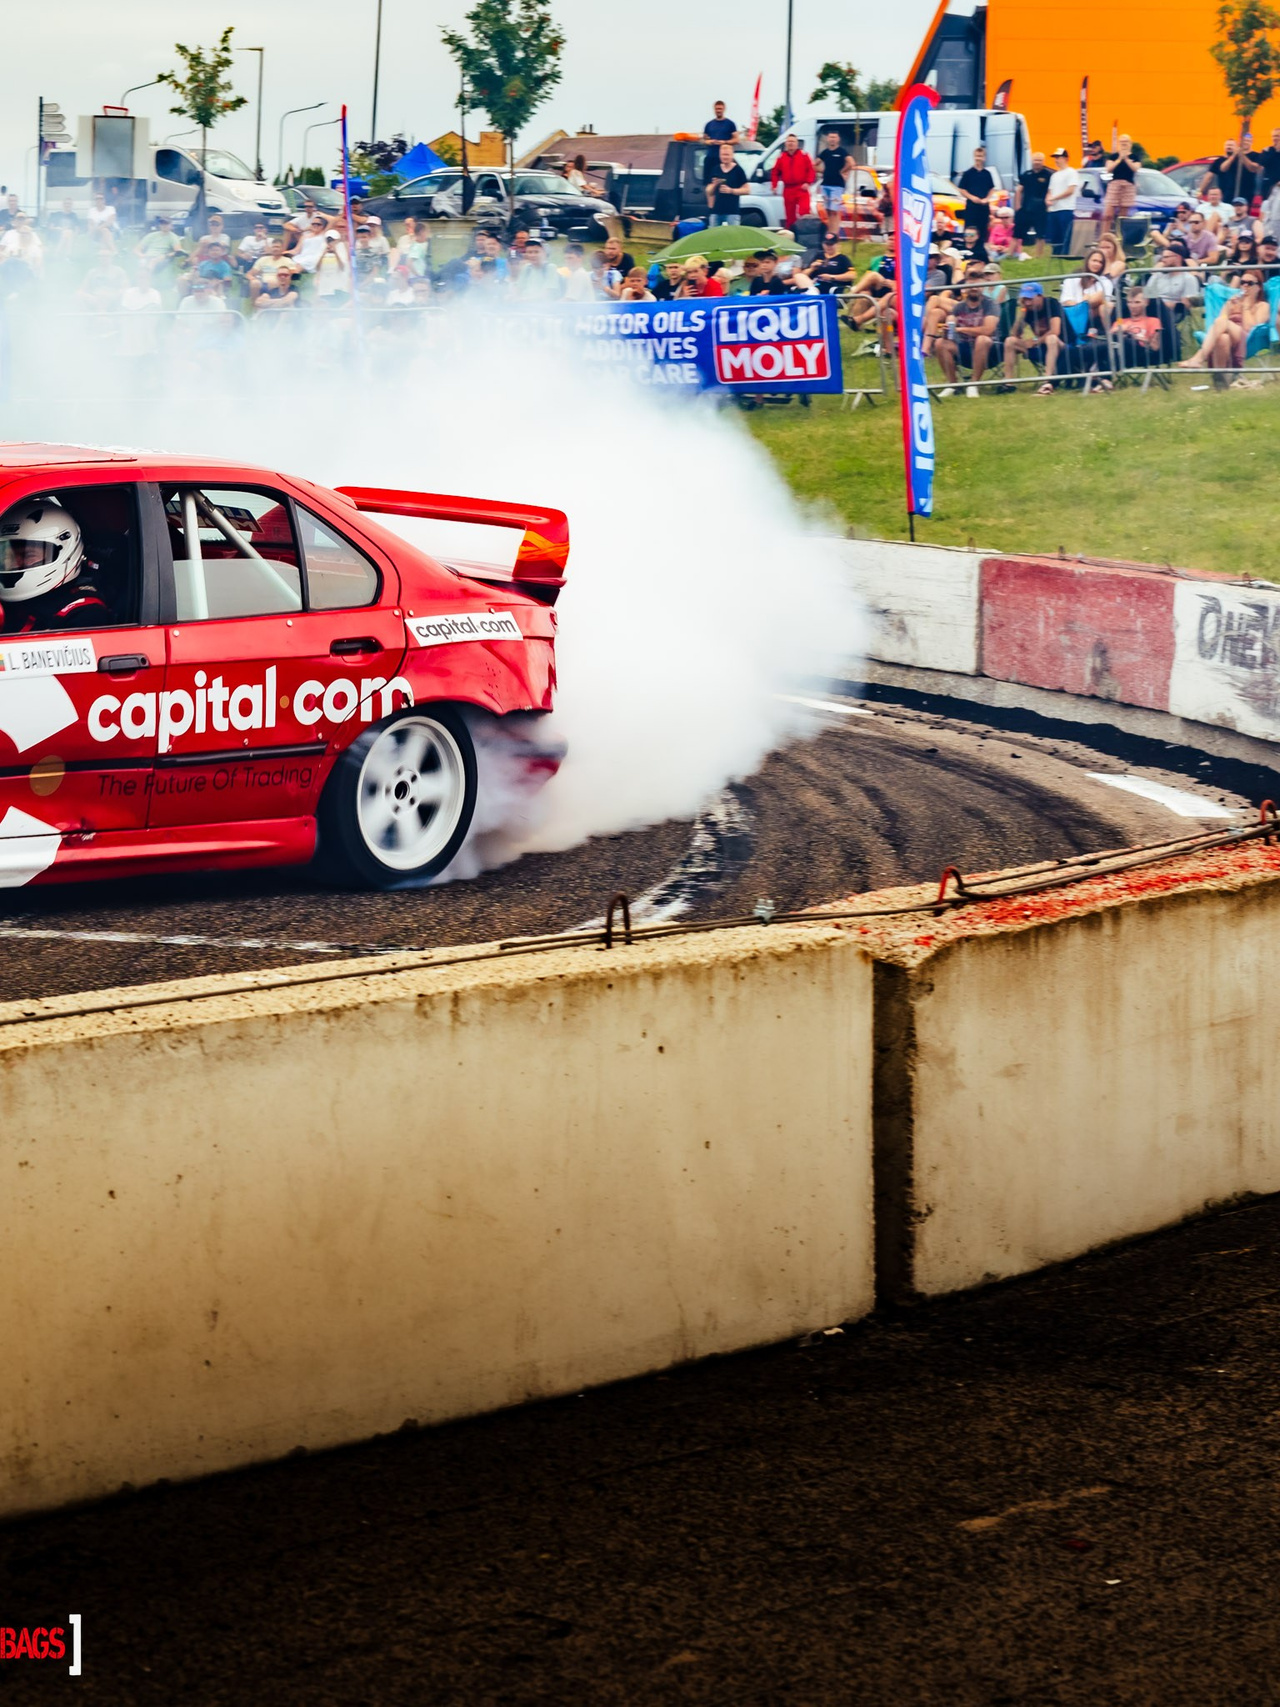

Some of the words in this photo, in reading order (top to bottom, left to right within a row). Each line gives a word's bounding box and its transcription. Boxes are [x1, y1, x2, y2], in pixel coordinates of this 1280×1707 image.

[575, 313, 648, 335] MOTOR
[653, 310, 706, 333] OILS
[719, 304, 819, 342] LIQUI
[583, 337, 698, 361] ADDITIVES
[720, 342, 824, 379] MOLY
[637, 363, 700, 384] CARE
[98, 773, 137, 797] The
[143, 765, 207, 796] Future
[213, 768, 237, 791] Of
[244, 764, 313, 789] Trading
